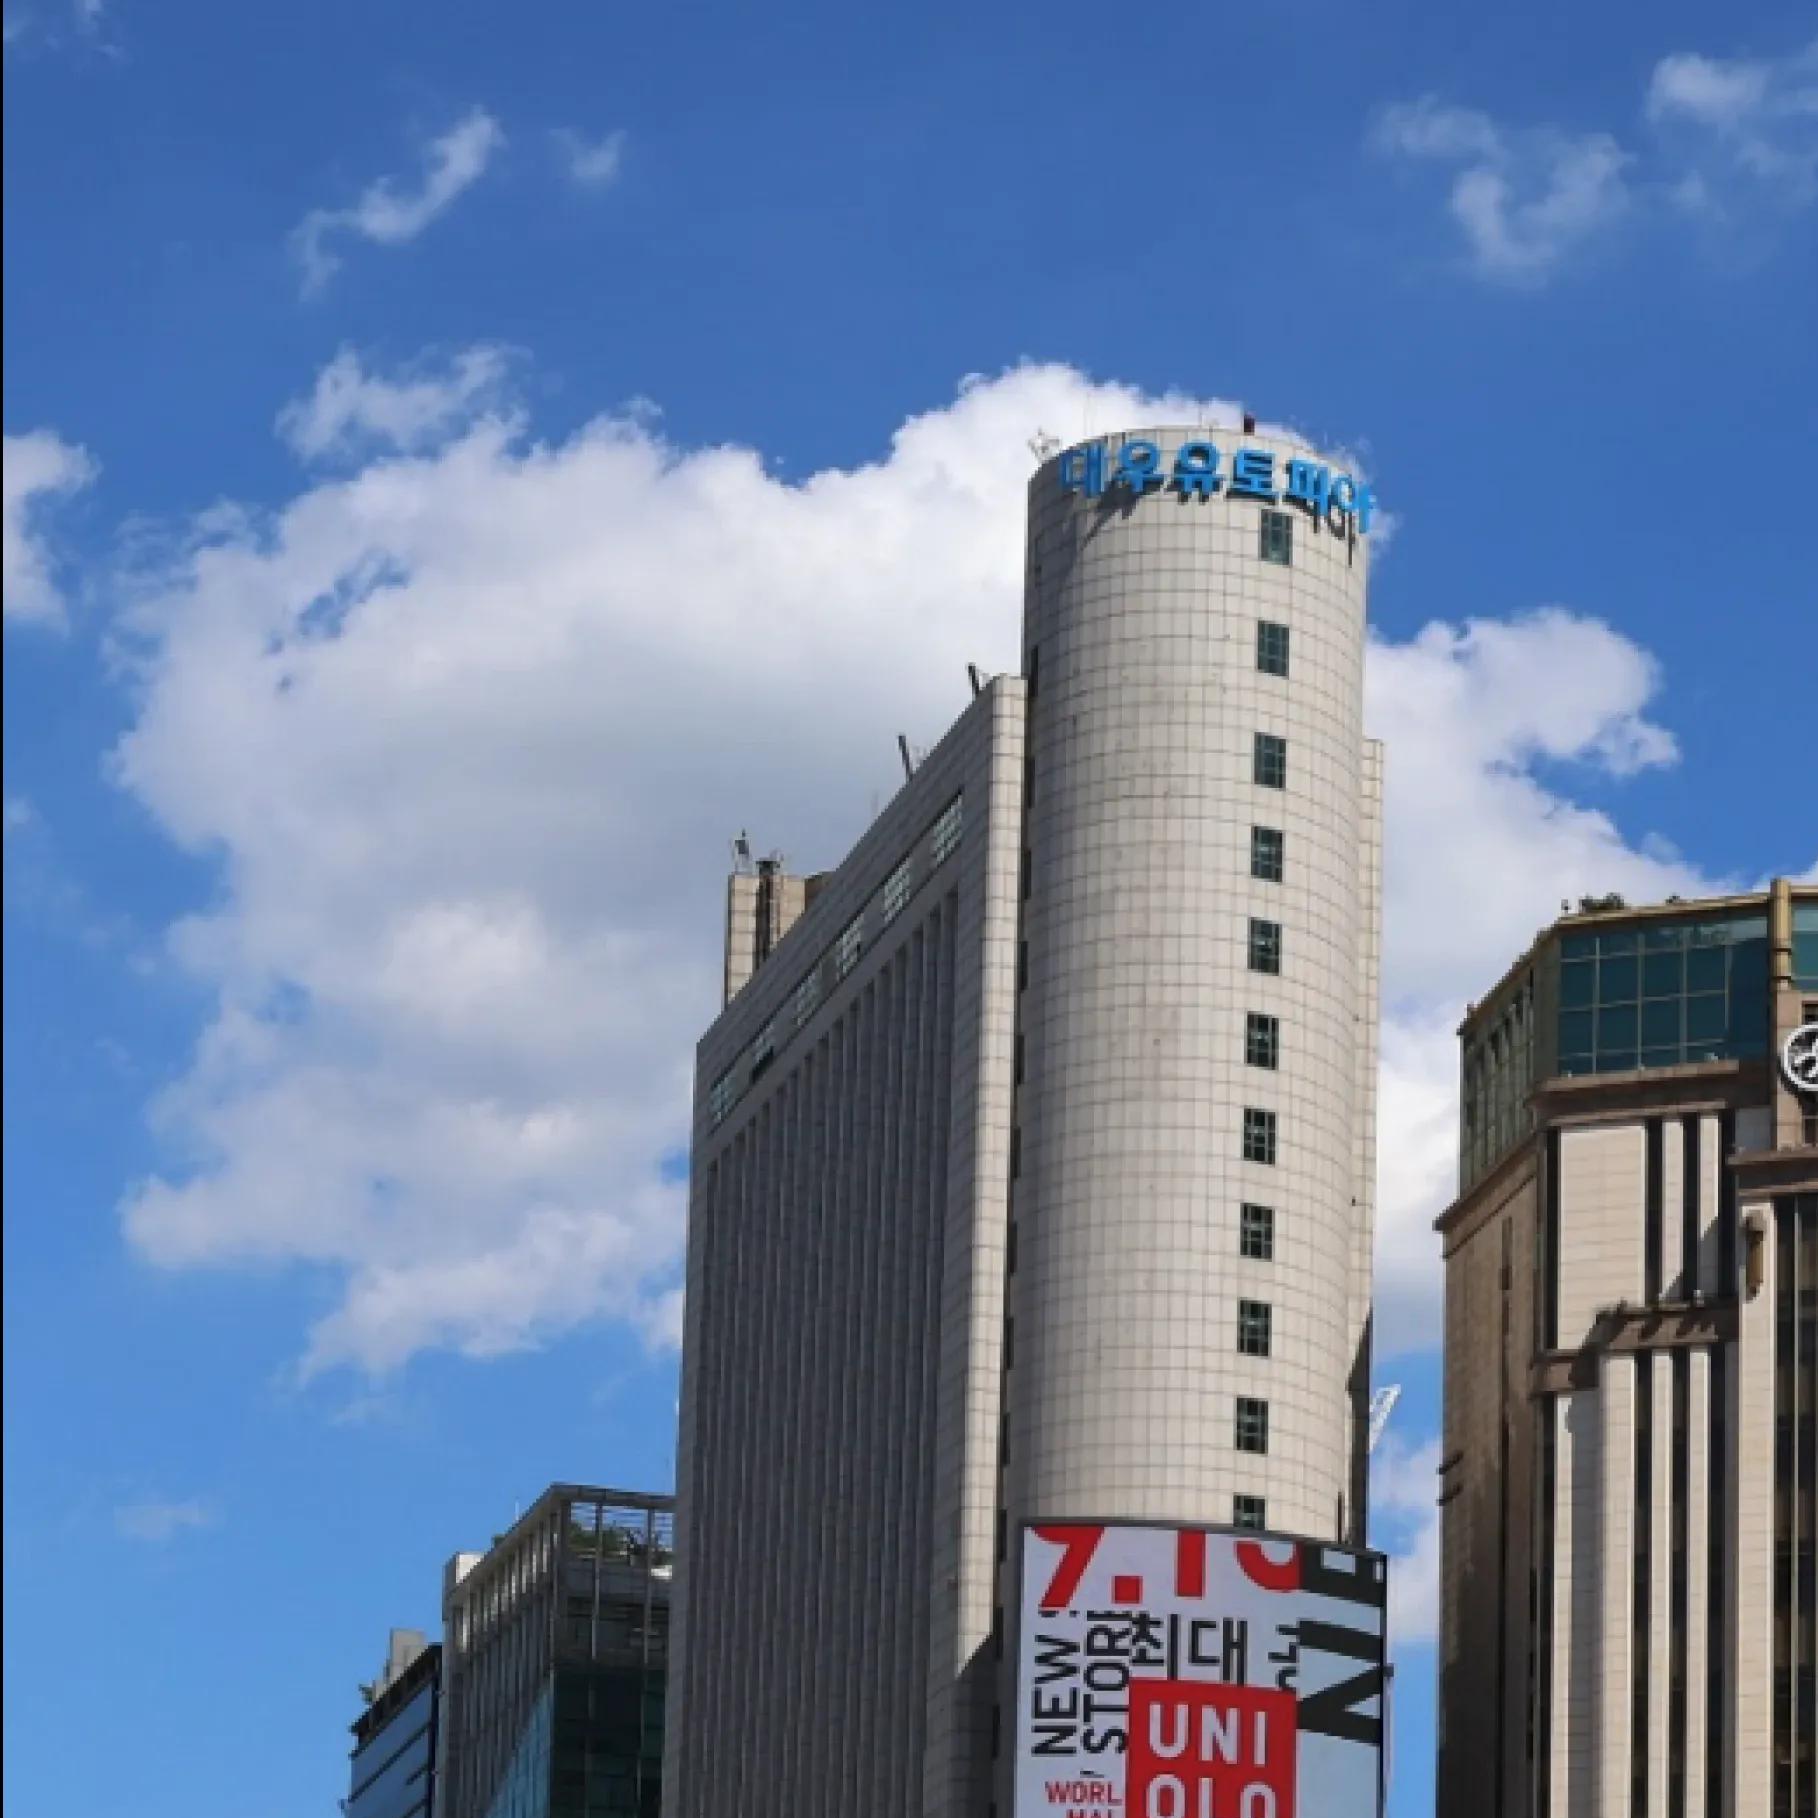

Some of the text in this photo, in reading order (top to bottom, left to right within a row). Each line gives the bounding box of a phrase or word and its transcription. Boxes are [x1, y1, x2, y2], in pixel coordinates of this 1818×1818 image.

[1058, 438, 1378, 534] 대우유토피아
[1031, 1634, 1080, 1757] NEW
[1081, 1610, 1131, 1756] STOR
[1148, 1701, 1267, 1767] UNI
[1045, 1780, 1123, 1803] WORL
